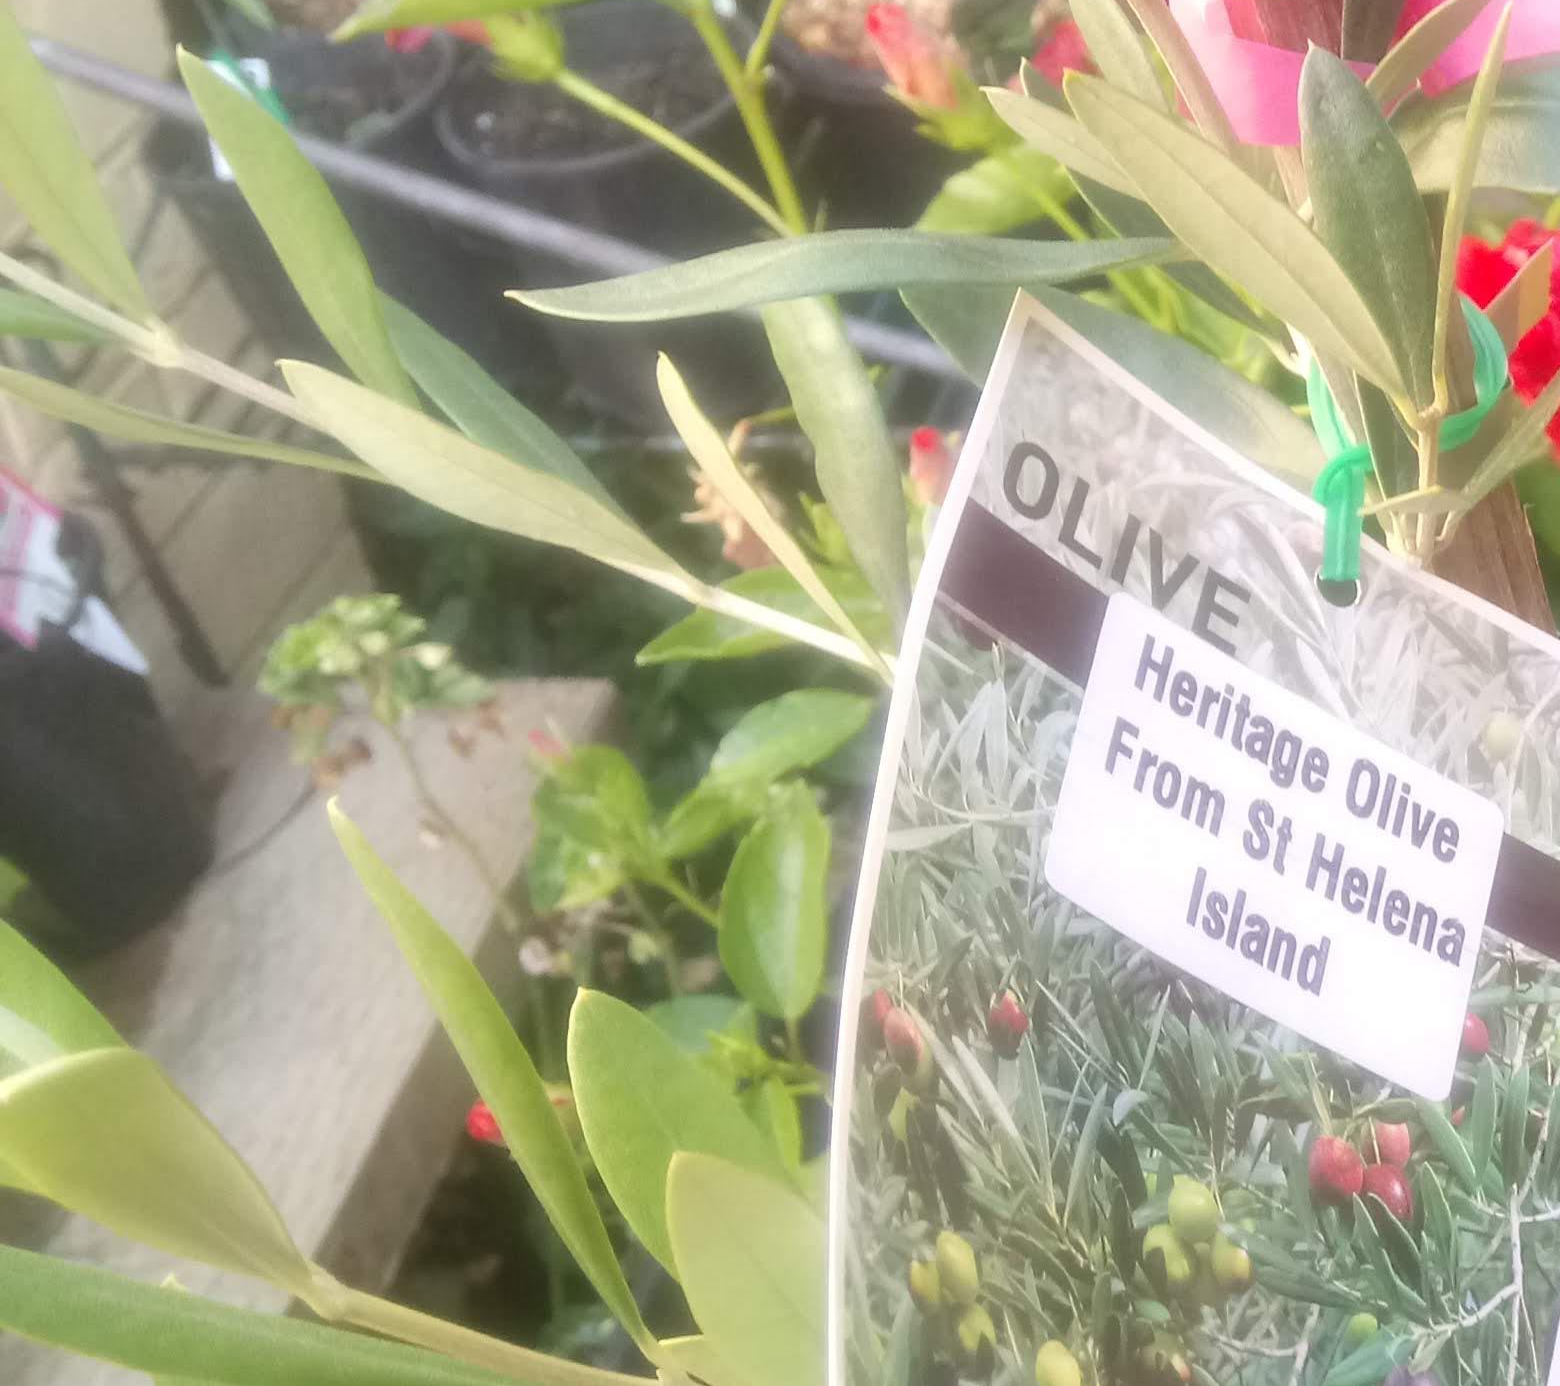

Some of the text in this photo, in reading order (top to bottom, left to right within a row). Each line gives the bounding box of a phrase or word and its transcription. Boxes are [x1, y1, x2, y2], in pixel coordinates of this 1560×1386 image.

[1001, 440, 1252, 656] OLIVE
[1104, 716, 1467, 967] From St Helena
[1134, 634, 1461, 864] Heritage Olive
[1185, 867, 1333, 997] Island
